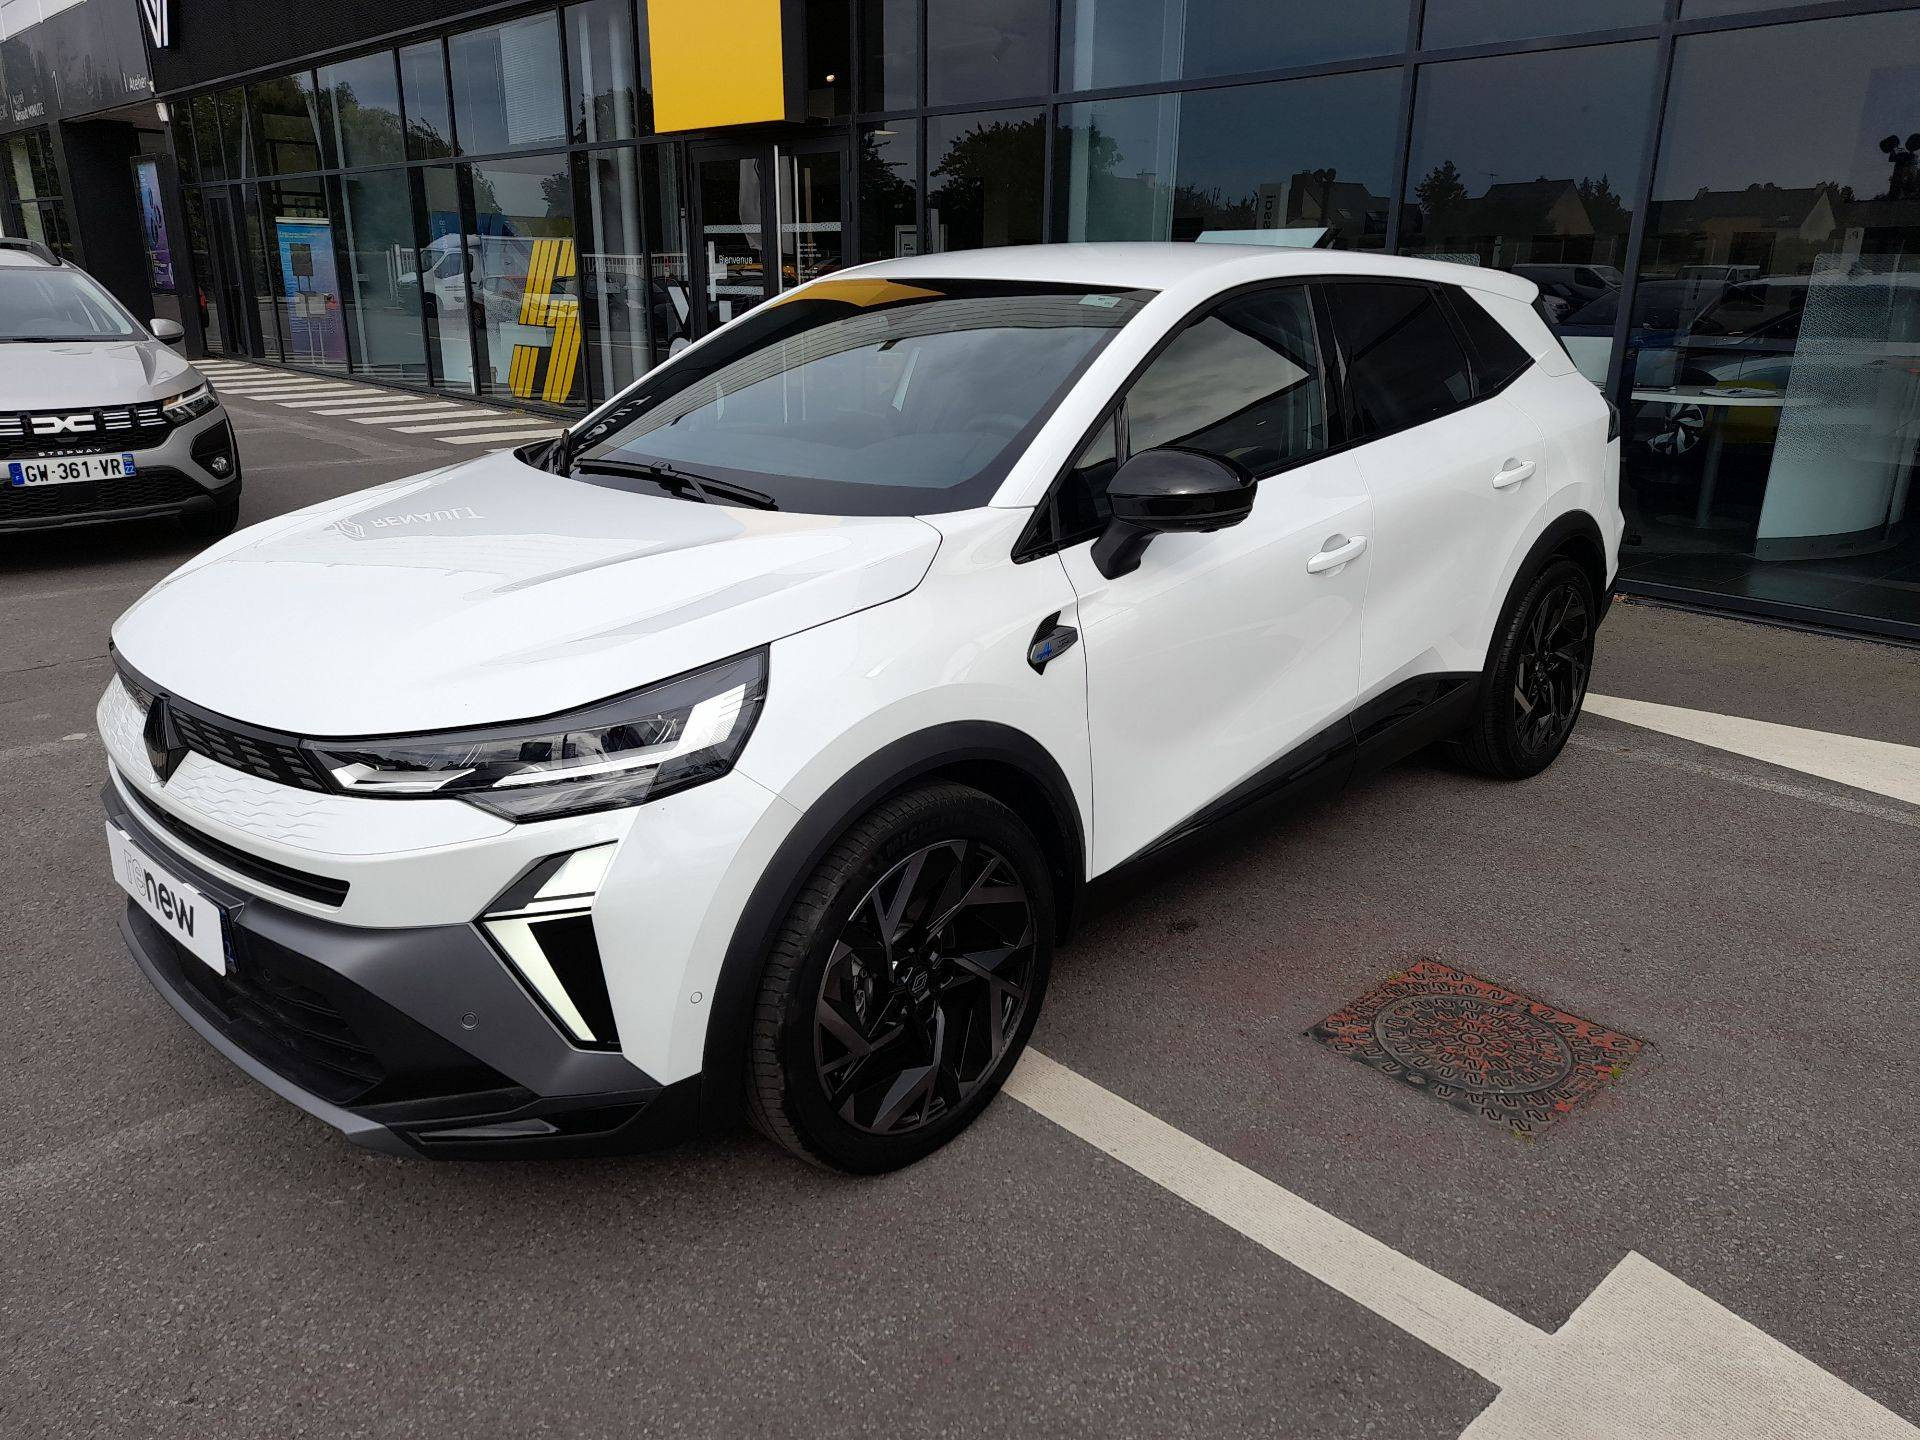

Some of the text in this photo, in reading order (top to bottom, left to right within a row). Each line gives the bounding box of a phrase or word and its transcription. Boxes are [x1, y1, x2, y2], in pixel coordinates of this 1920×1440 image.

[718, 254, 753, 265] Bienvenue
[38, 448, 103, 457] STEPWAY
[25, 458, 122, 482] GW-361-VR
